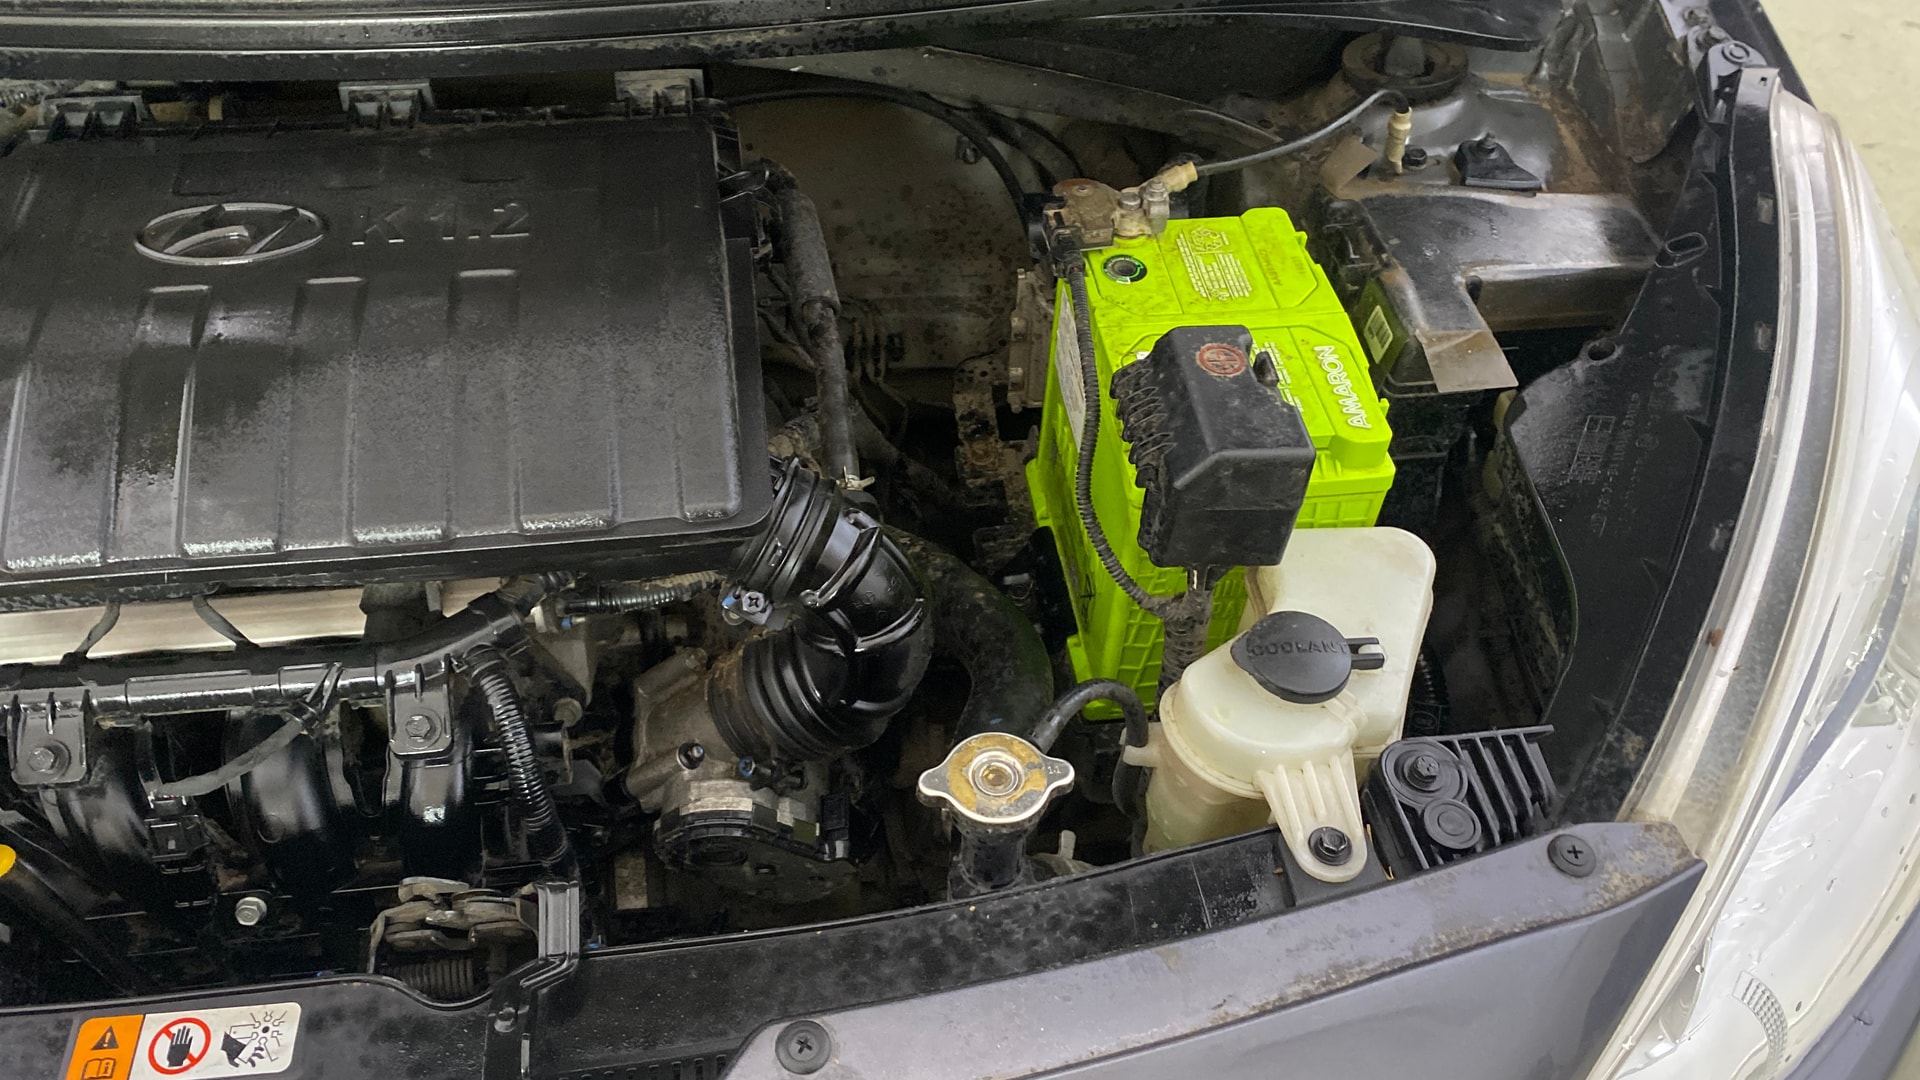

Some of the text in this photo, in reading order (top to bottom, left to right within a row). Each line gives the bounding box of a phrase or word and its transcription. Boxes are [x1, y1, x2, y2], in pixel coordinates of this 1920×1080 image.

[352, 204, 409, 245] K
[1314, 345, 1372, 429] AMARON
[1250, 638, 1349, 658] COOLANT
